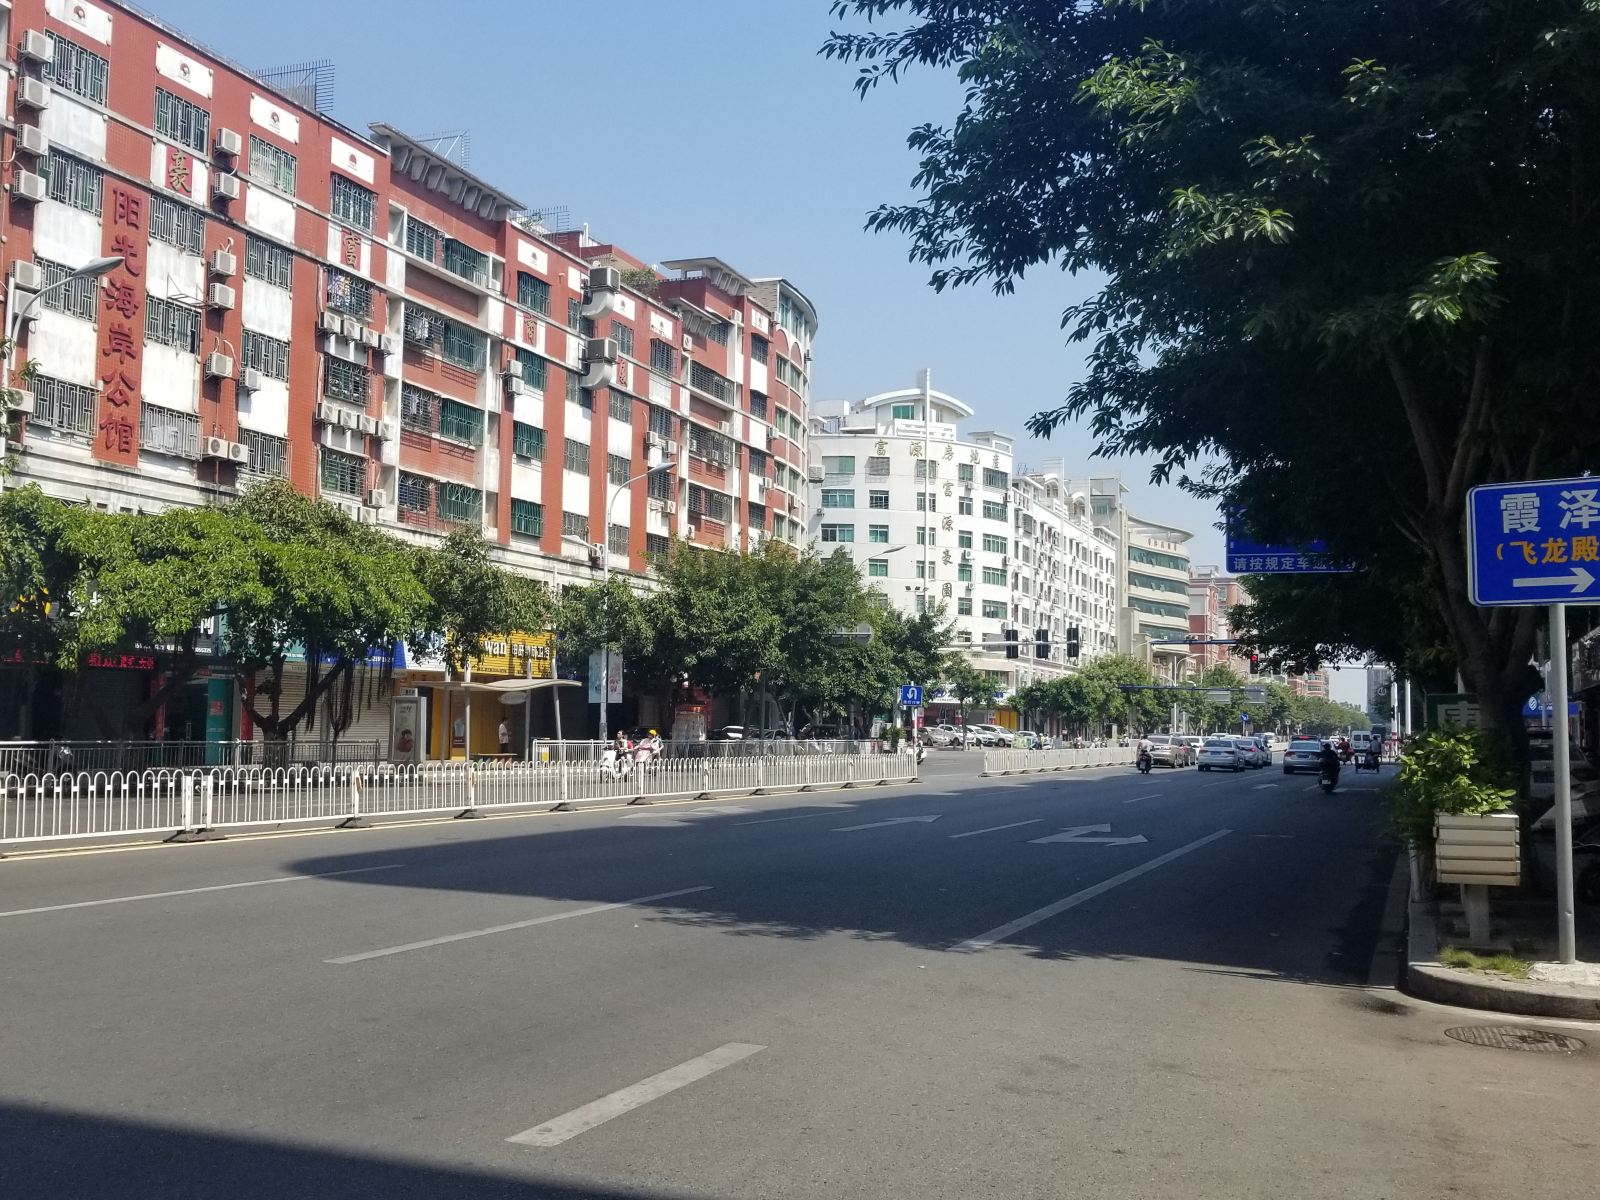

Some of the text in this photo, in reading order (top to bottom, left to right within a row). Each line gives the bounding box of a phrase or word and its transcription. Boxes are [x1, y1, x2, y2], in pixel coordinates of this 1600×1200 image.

[99, 187, 141, 453] 阳光海岸公馆
[1500, 489, 1600, 533] 霞泽
